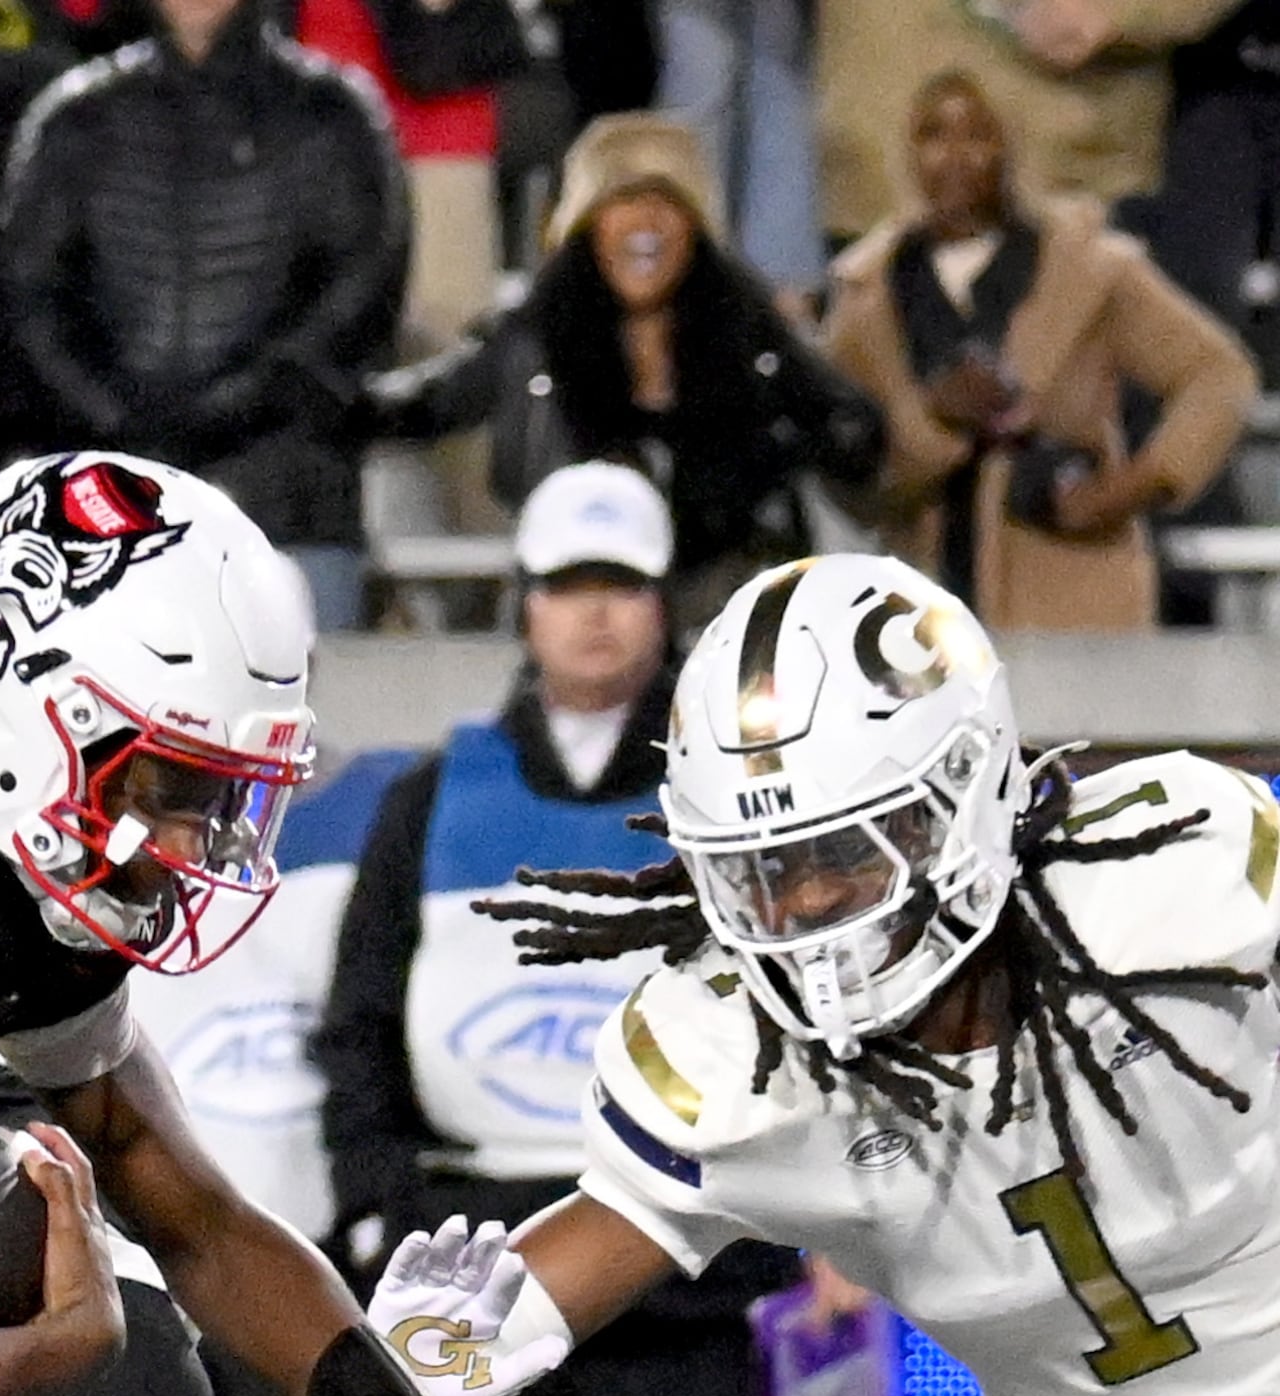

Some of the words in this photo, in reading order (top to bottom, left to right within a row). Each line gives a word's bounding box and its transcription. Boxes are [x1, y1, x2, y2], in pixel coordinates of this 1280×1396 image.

[736, 782, 795, 821] UATW
[997, 1163, 1202, 1387] 1
[386, 1315, 493, 1391] GT
